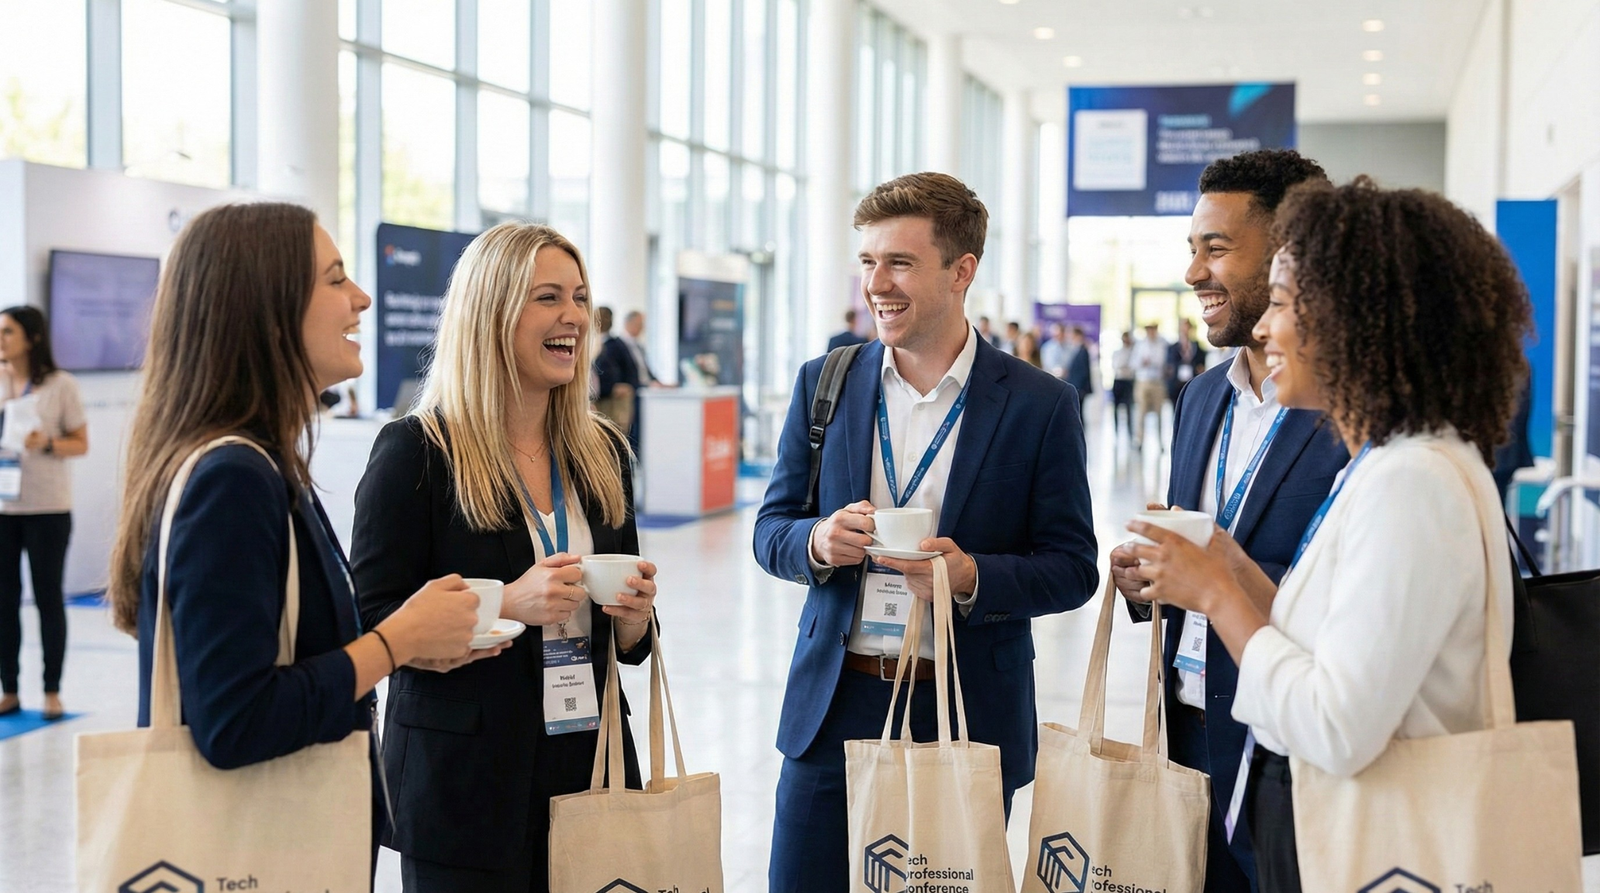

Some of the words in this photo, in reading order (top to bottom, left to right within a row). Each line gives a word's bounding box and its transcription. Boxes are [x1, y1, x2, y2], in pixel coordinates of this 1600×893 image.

[907, 867, 974, 881] rofessional
[216, 875, 258, 892] Tech
[906, 881, 969, 893] onference
